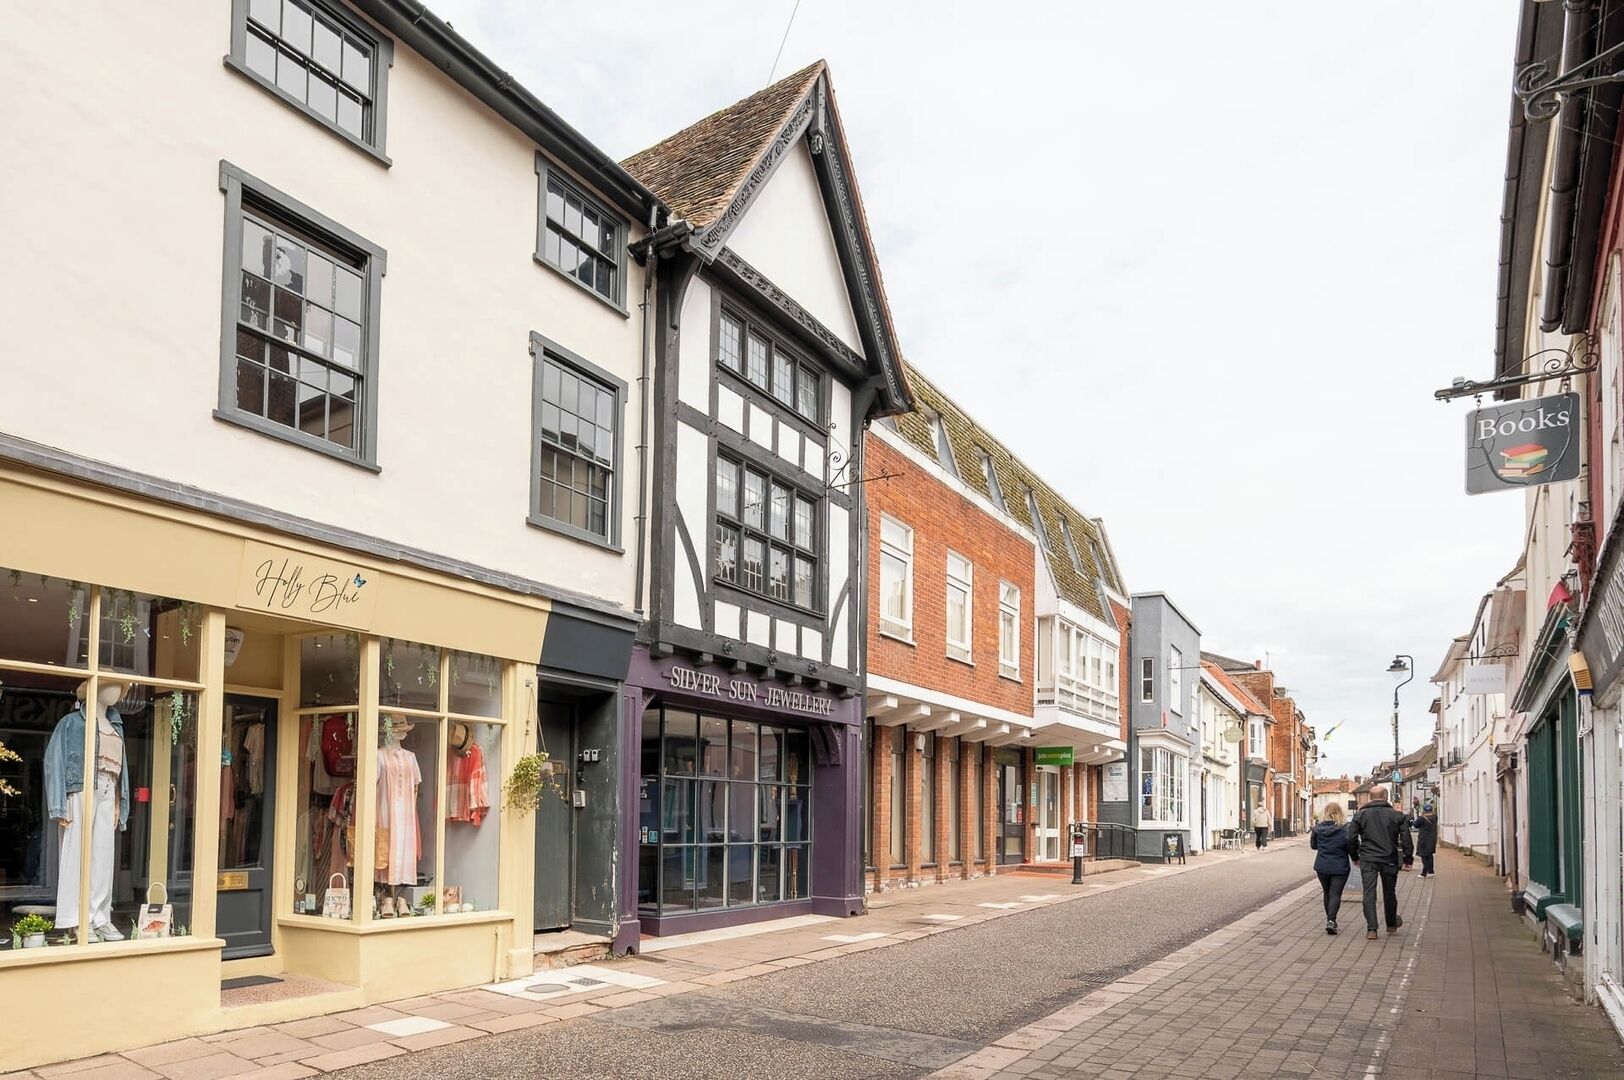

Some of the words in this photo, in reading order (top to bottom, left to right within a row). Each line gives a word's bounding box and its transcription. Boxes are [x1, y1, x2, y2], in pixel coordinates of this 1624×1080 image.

[1477, 407, 1570, 441] Books
[255, 558, 306, 609] Holly
[308, 572, 360, 613] Blue
[670, 665, 721, 696] SILVER
[728, 679, 758, 703] SUN
[764, 687, 832, 716] JEWELLERY
